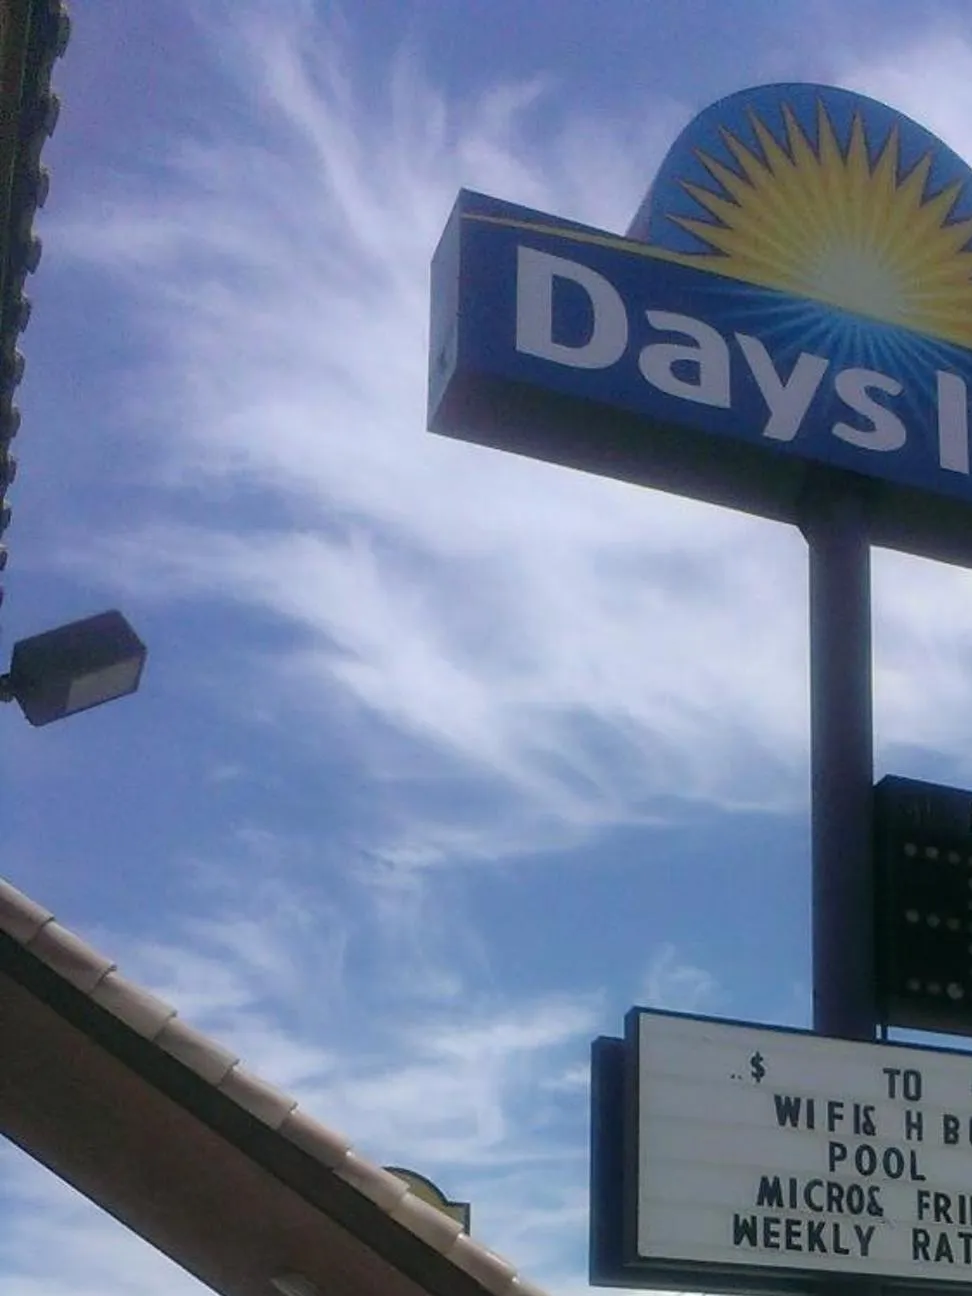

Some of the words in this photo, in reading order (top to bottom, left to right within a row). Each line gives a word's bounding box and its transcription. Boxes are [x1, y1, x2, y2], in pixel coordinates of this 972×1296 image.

[515, 245, 908, 453] Days
[883, 1067, 922, 1101] TO
[828, 1141, 926, 1181] POOL
[733, 1213, 875, 1257] WEEKLY
